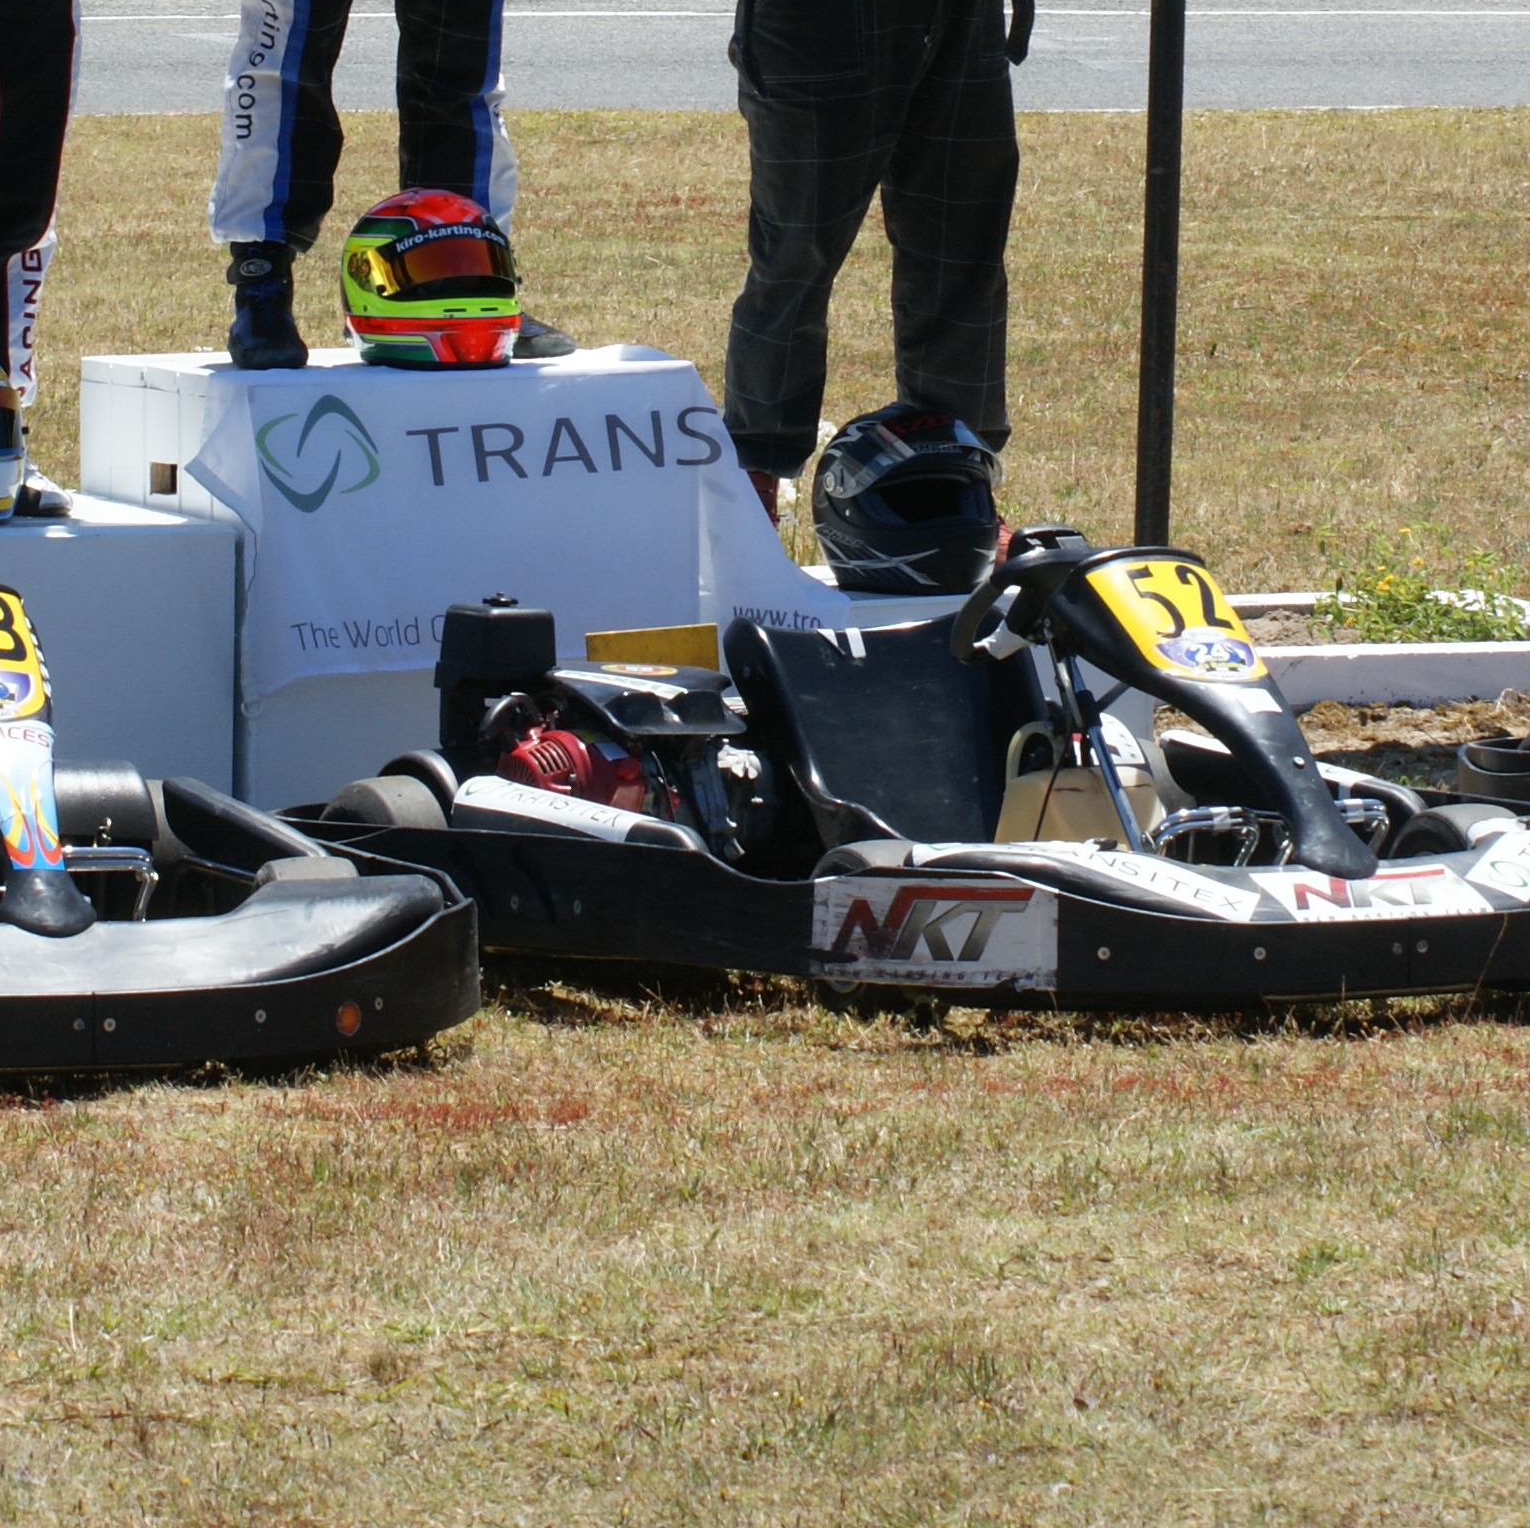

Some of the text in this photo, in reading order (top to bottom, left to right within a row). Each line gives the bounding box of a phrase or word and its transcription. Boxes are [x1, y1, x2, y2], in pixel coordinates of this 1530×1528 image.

[1125, 563, 1236, 639] 52
[290, 622, 341, 651] The
[343, 617, 420, 649] World
[1291, 868, 1446, 910] NKT
[831, 886, 1036, 962] NKT
